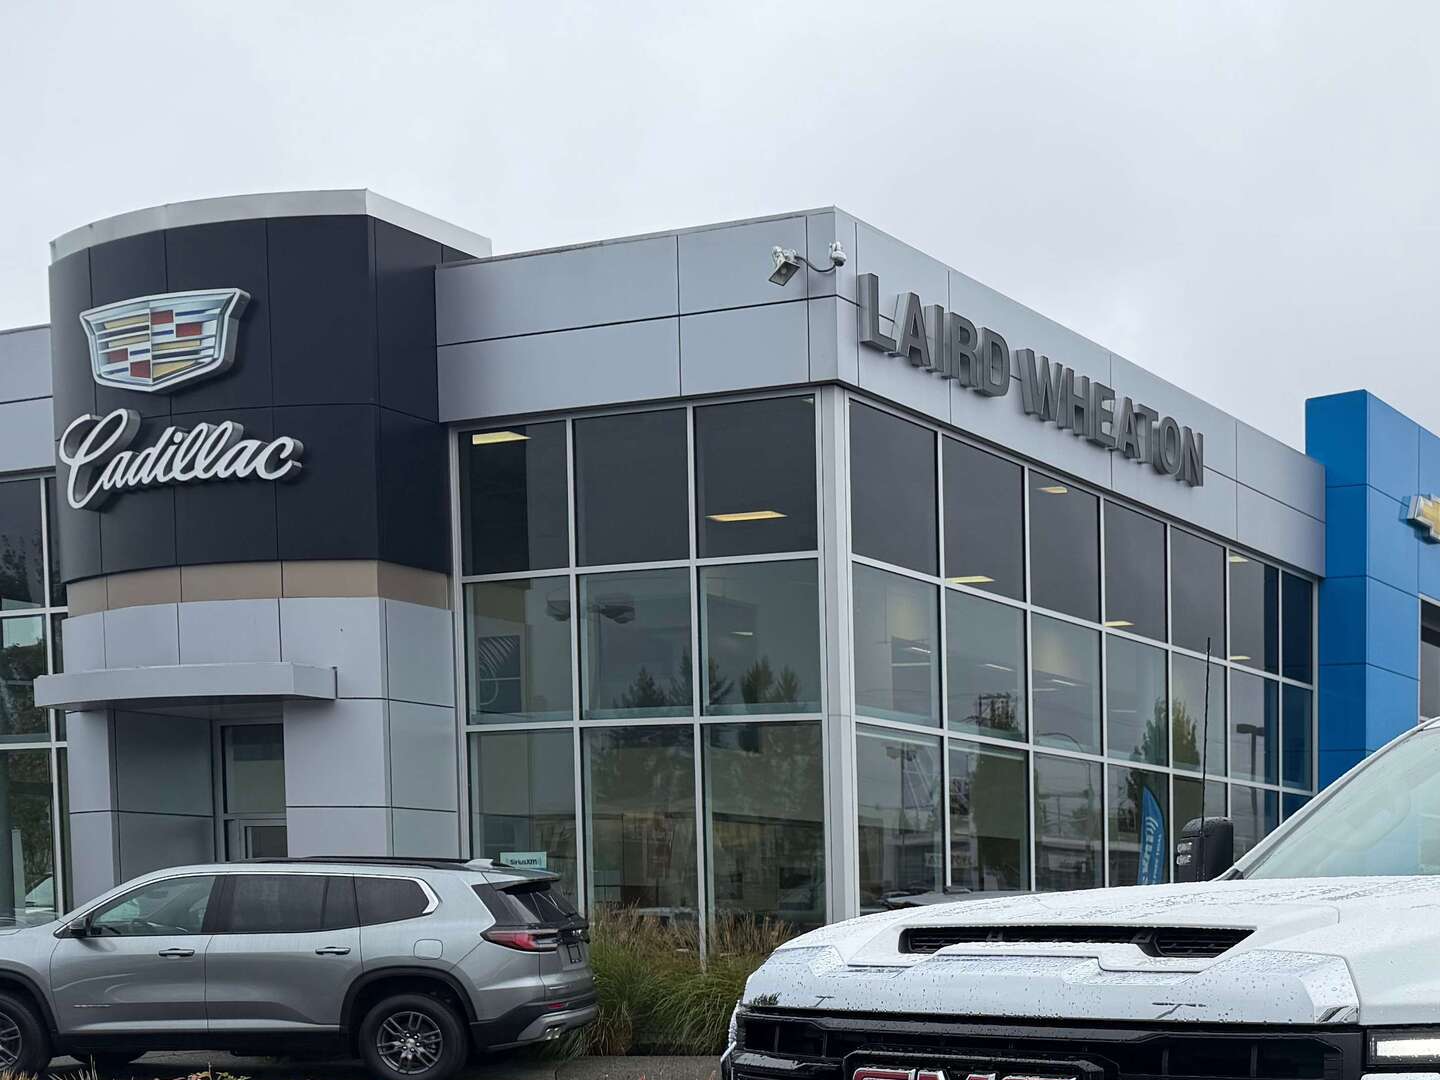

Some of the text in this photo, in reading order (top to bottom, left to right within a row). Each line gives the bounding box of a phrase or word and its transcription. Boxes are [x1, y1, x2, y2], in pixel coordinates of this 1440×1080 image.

[858, 272, 1204, 487] LAIRD WHEATON
[59, 408, 303, 510] Cadillac
